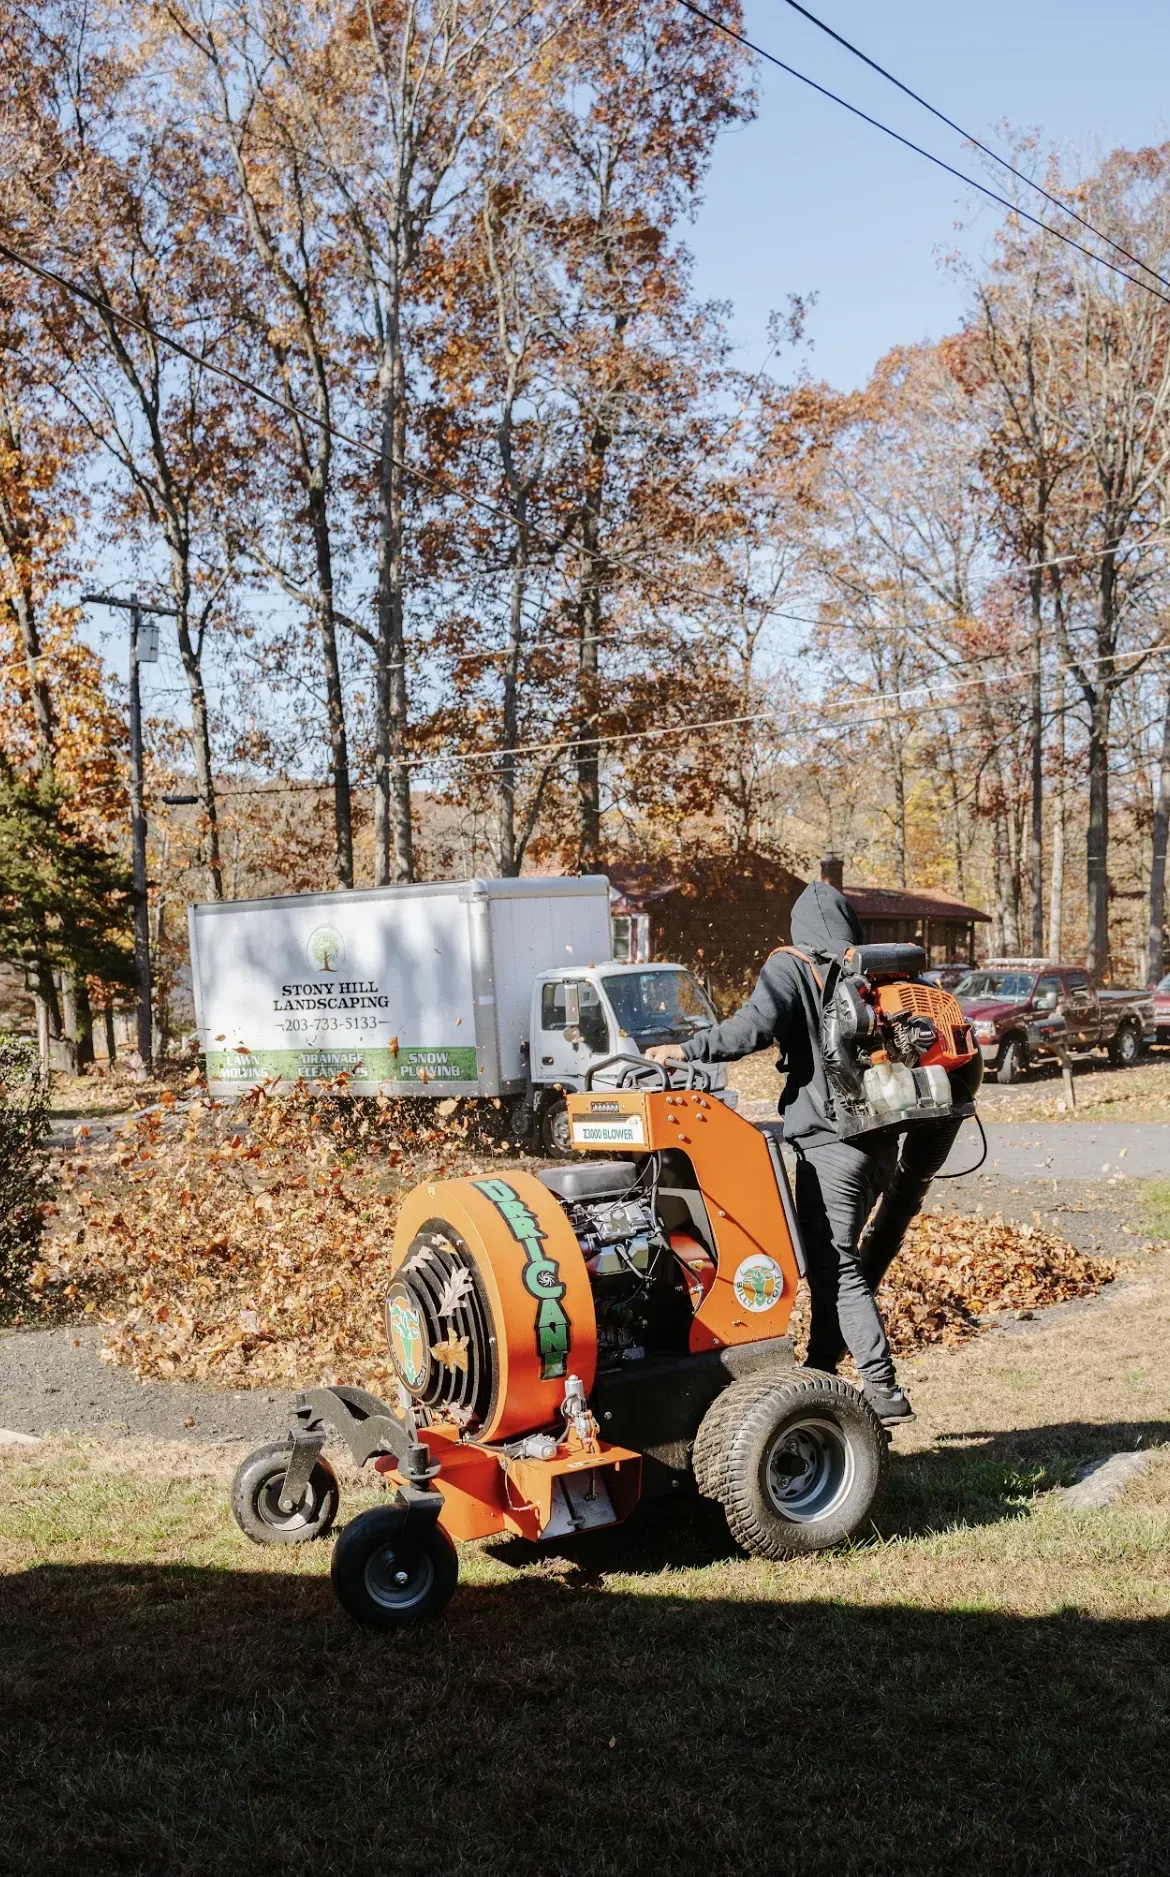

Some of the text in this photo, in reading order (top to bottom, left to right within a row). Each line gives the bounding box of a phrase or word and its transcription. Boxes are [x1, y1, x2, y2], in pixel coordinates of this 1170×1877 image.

[282, 981, 379, 997] STONY HILL
[273, 995, 390, 1012] LANDSCAPING
[226, 1055, 260, 1067] LAWN
[301, 1052, 365, 1065] DRAINAGE
[408, 1052, 449, 1065] SNOW
[297, 1066, 369, 1079] CLEAN-S
[582, 1128, 634, 1141] Z3000 BLOWER
